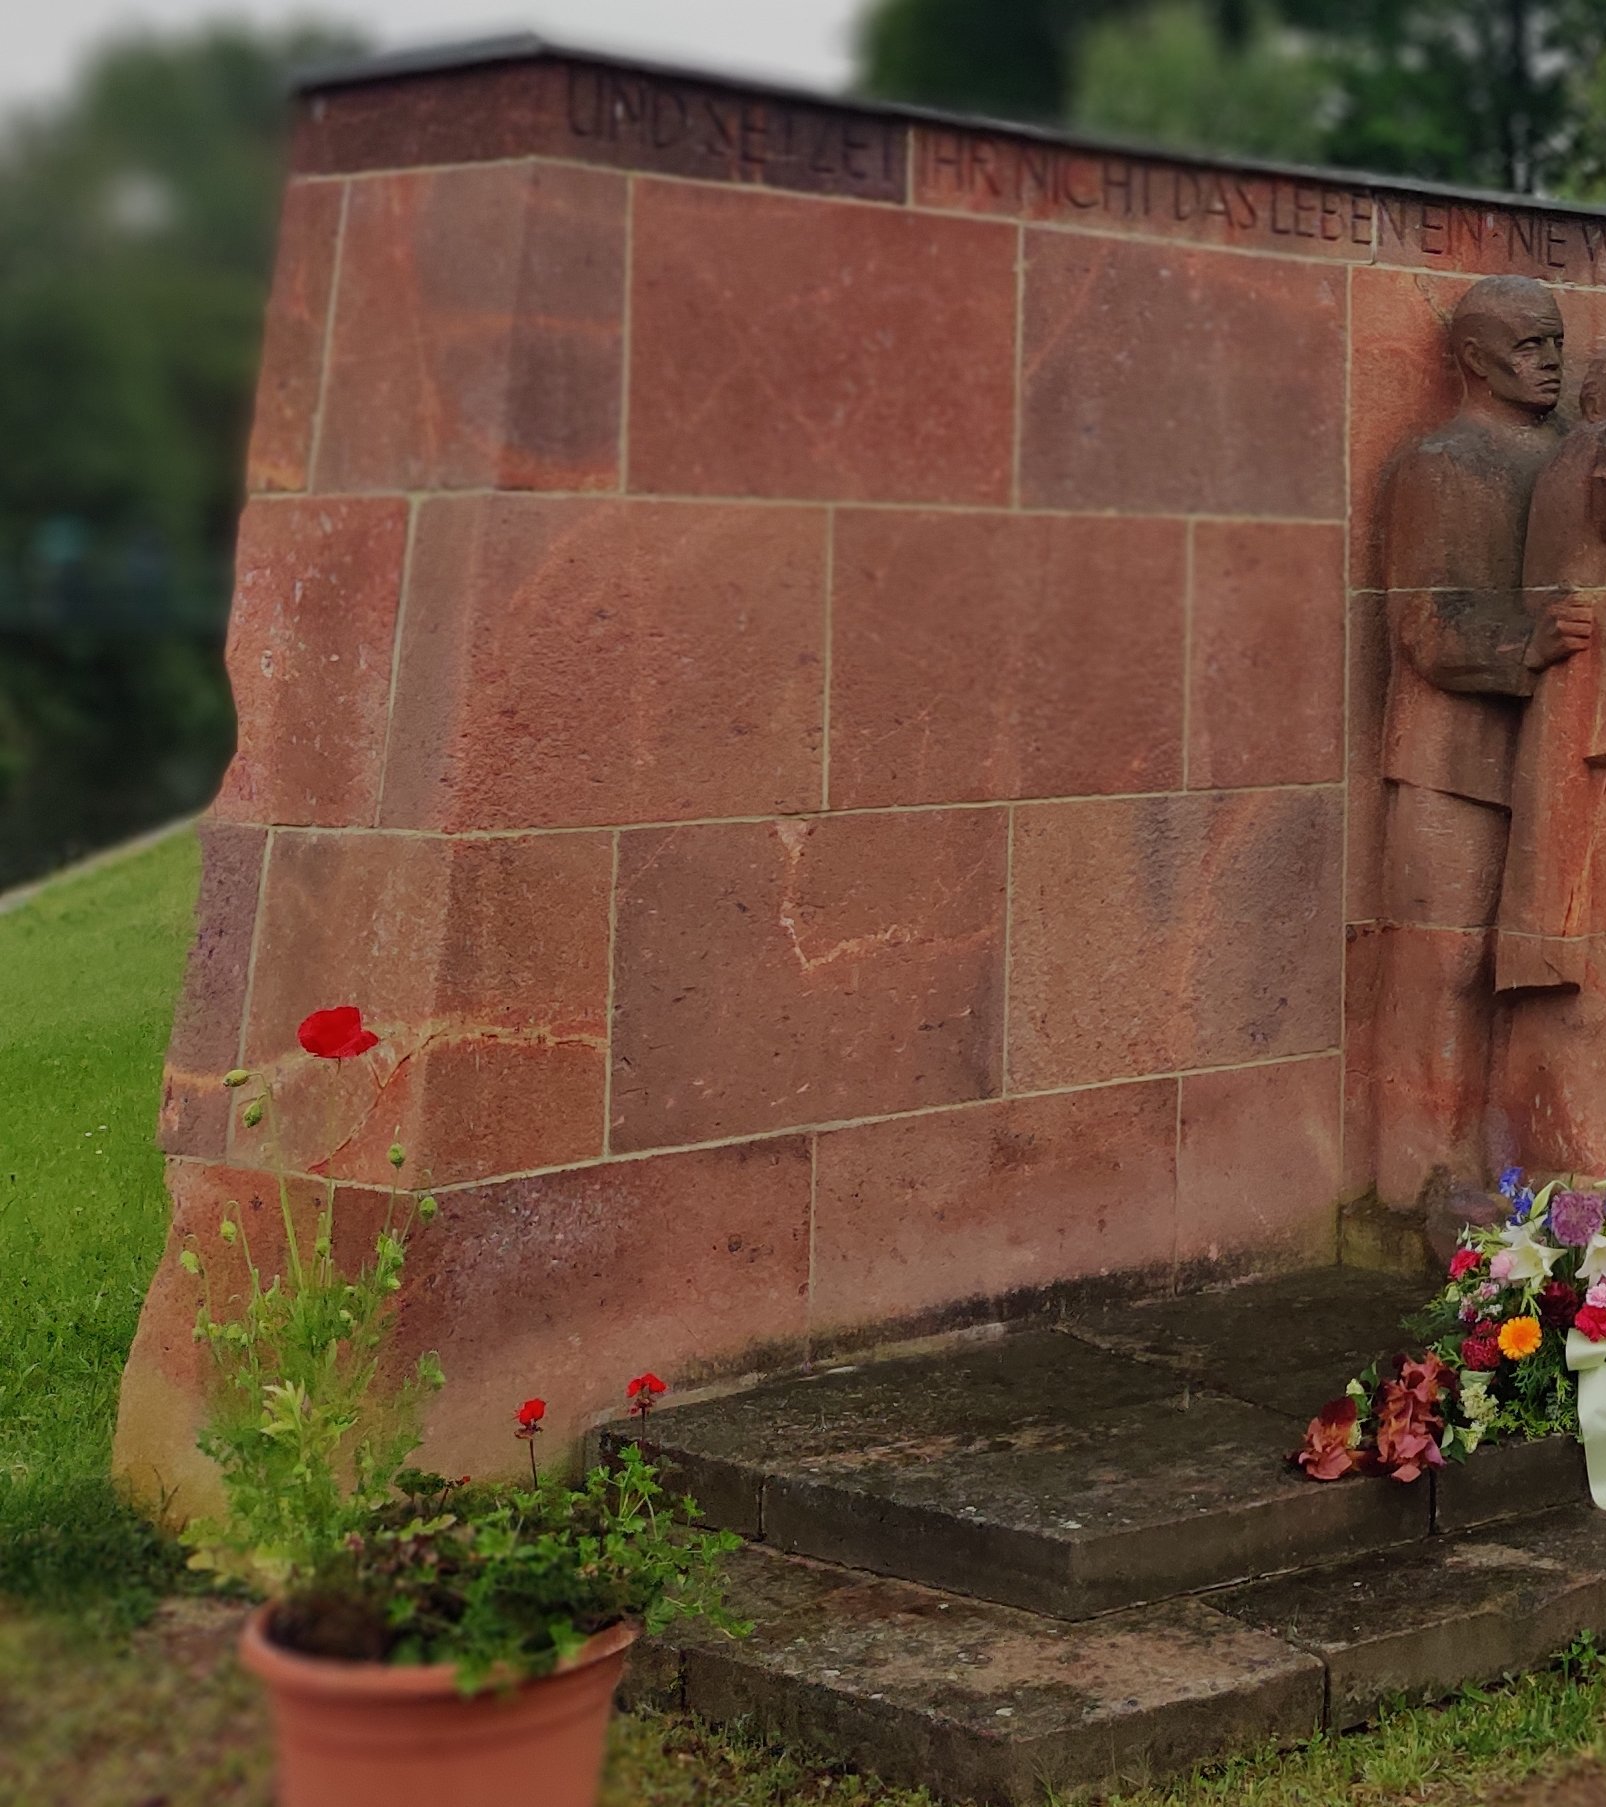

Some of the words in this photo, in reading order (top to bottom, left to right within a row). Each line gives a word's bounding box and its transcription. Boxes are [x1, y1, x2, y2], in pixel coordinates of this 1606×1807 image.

[568, 64, 688, 149] UND
[920, 130, 1001, 197] IHR
[1014, 144, 1153, 217] NICHT
[1172, 168, 1257, 230] DAS
[1269, 178, 1407, 246] LEBEN
[1421, 201, 1483, 259] EIN
[1507, 211, 1567, 269] NIE
